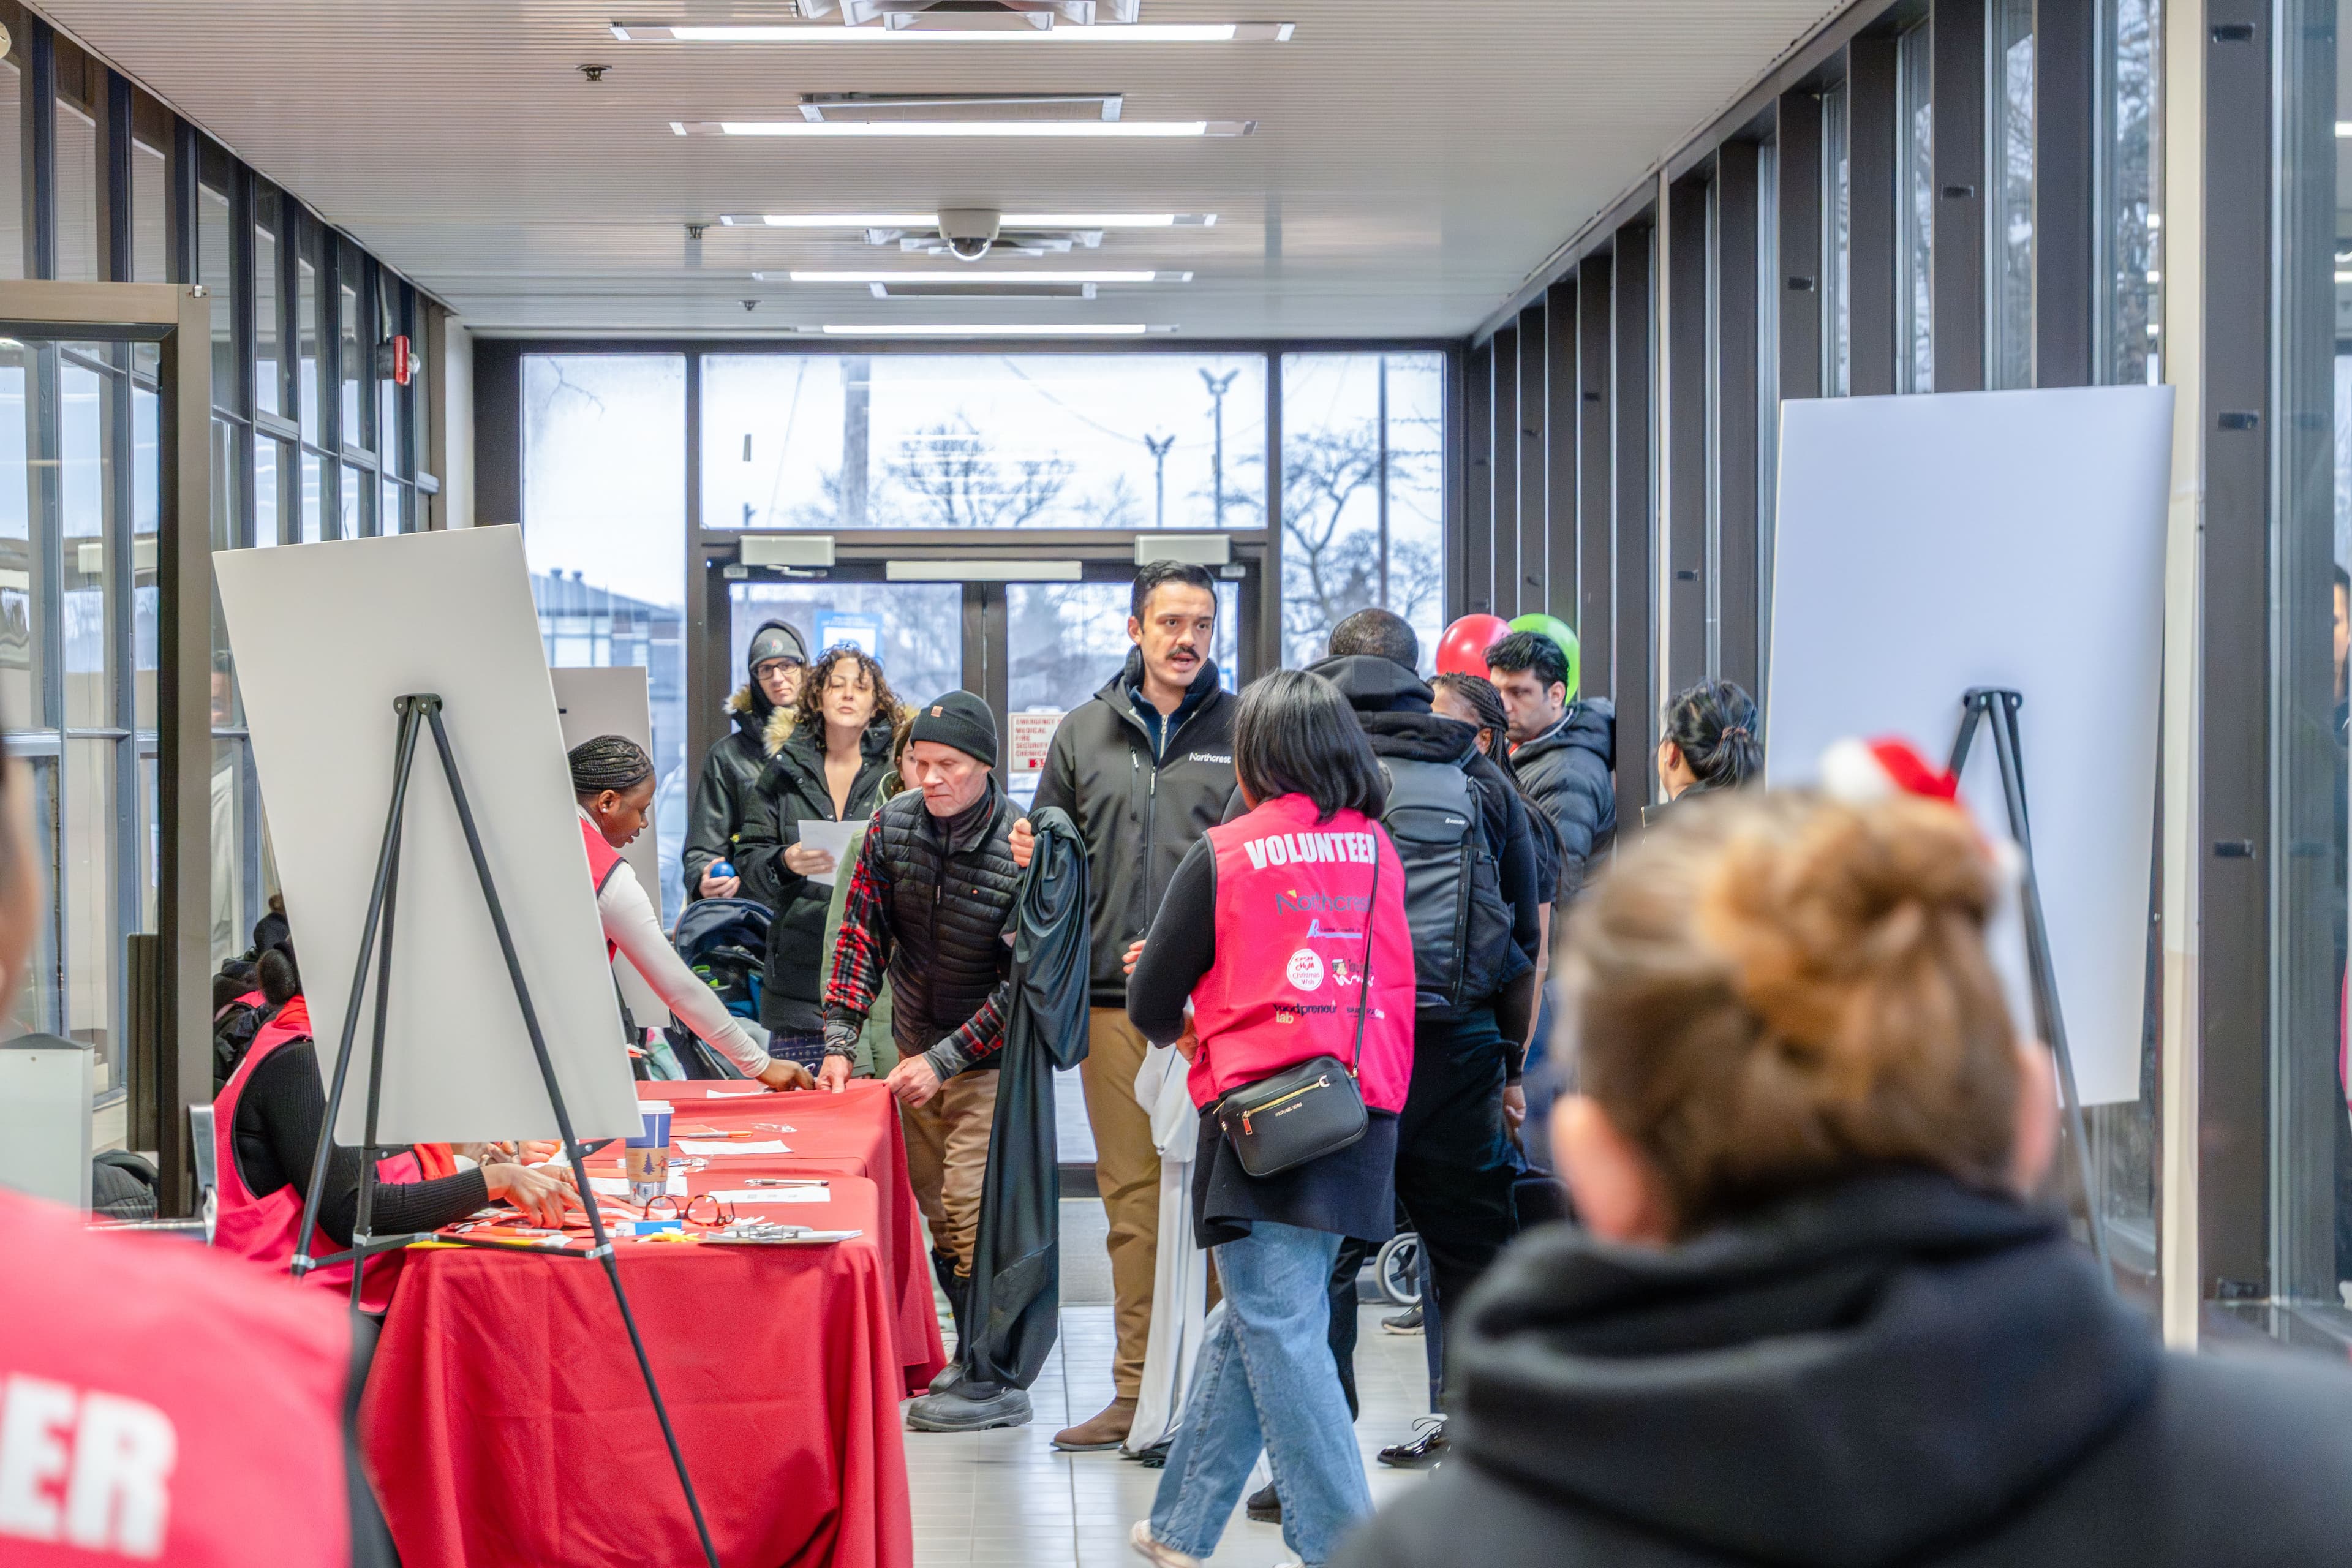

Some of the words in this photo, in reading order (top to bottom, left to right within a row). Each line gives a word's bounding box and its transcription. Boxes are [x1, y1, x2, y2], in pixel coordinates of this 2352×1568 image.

[1189, 752, 1231, 764] Northcrest
[1243, 832, 1376, 870] VOLUNTEER
[1276, 1010, 1294, 1024] lab
